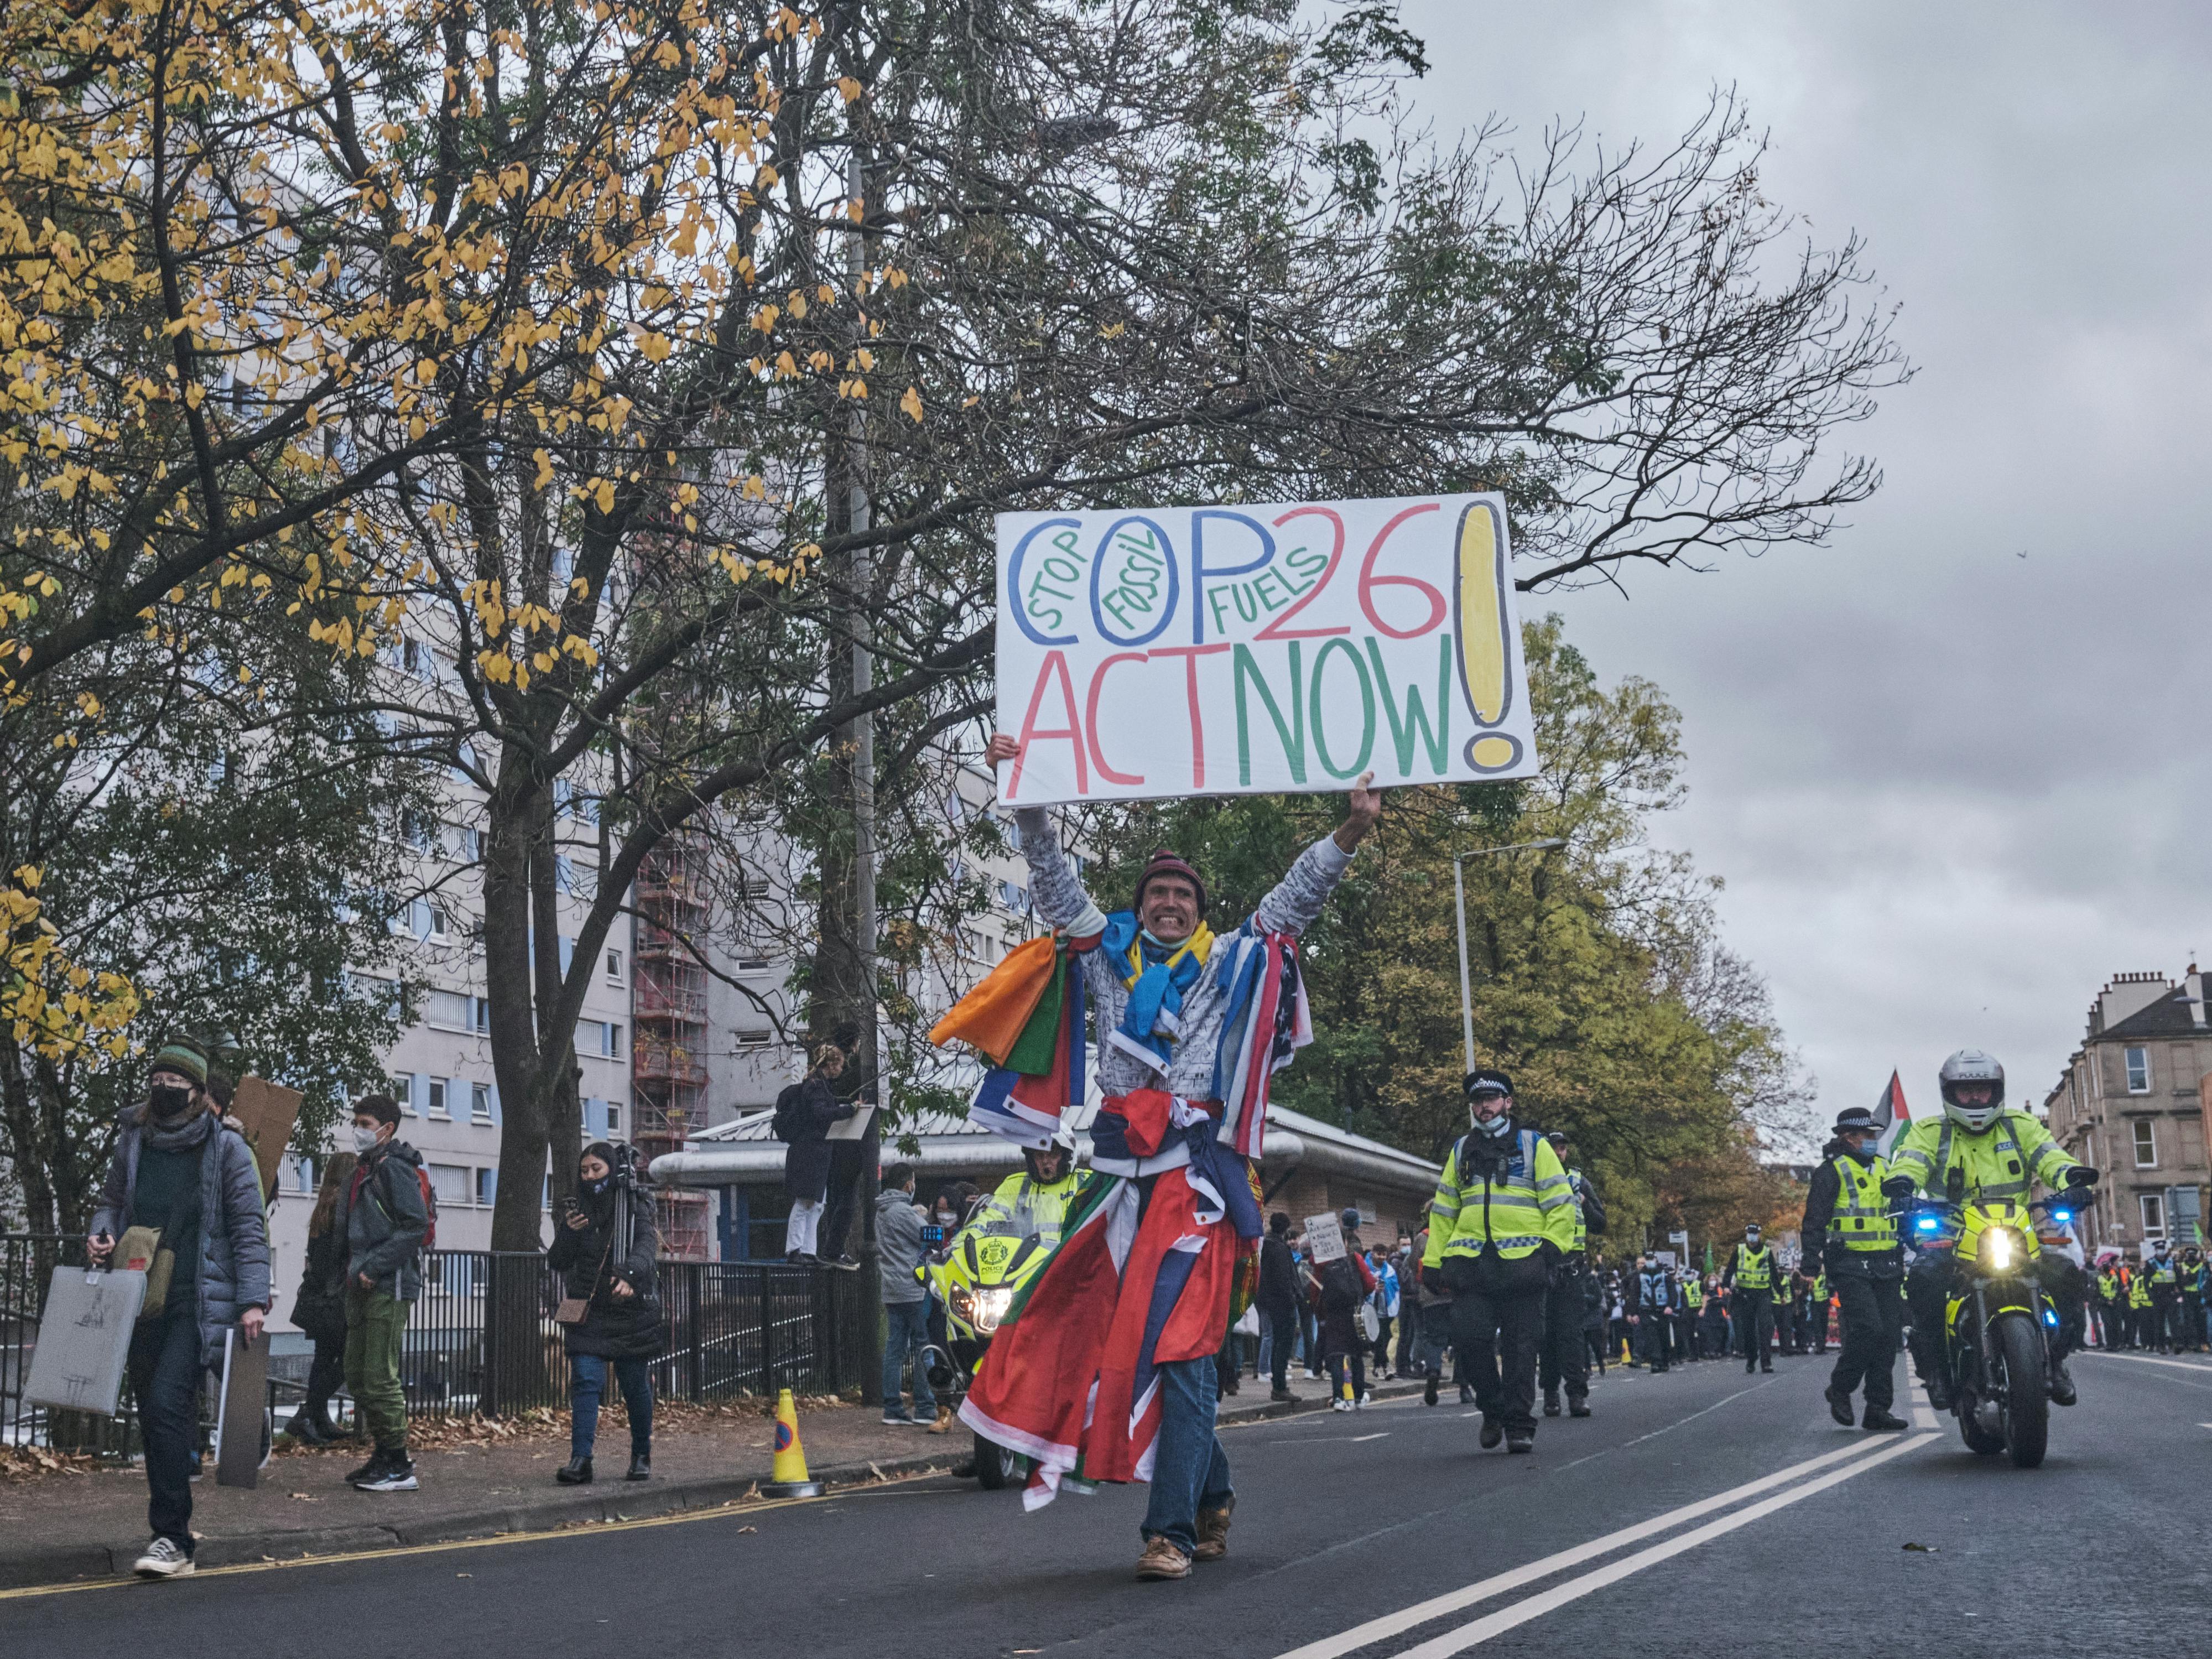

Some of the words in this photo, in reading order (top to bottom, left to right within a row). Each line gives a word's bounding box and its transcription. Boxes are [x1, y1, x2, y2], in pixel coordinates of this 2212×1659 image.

[1007, 502, 1447, 647] COP26
[1028, 531, 1089, 630] STOP
[1207, 546, 1329, 635] FUELS
[1006, 643, 1231, 799] ACT
